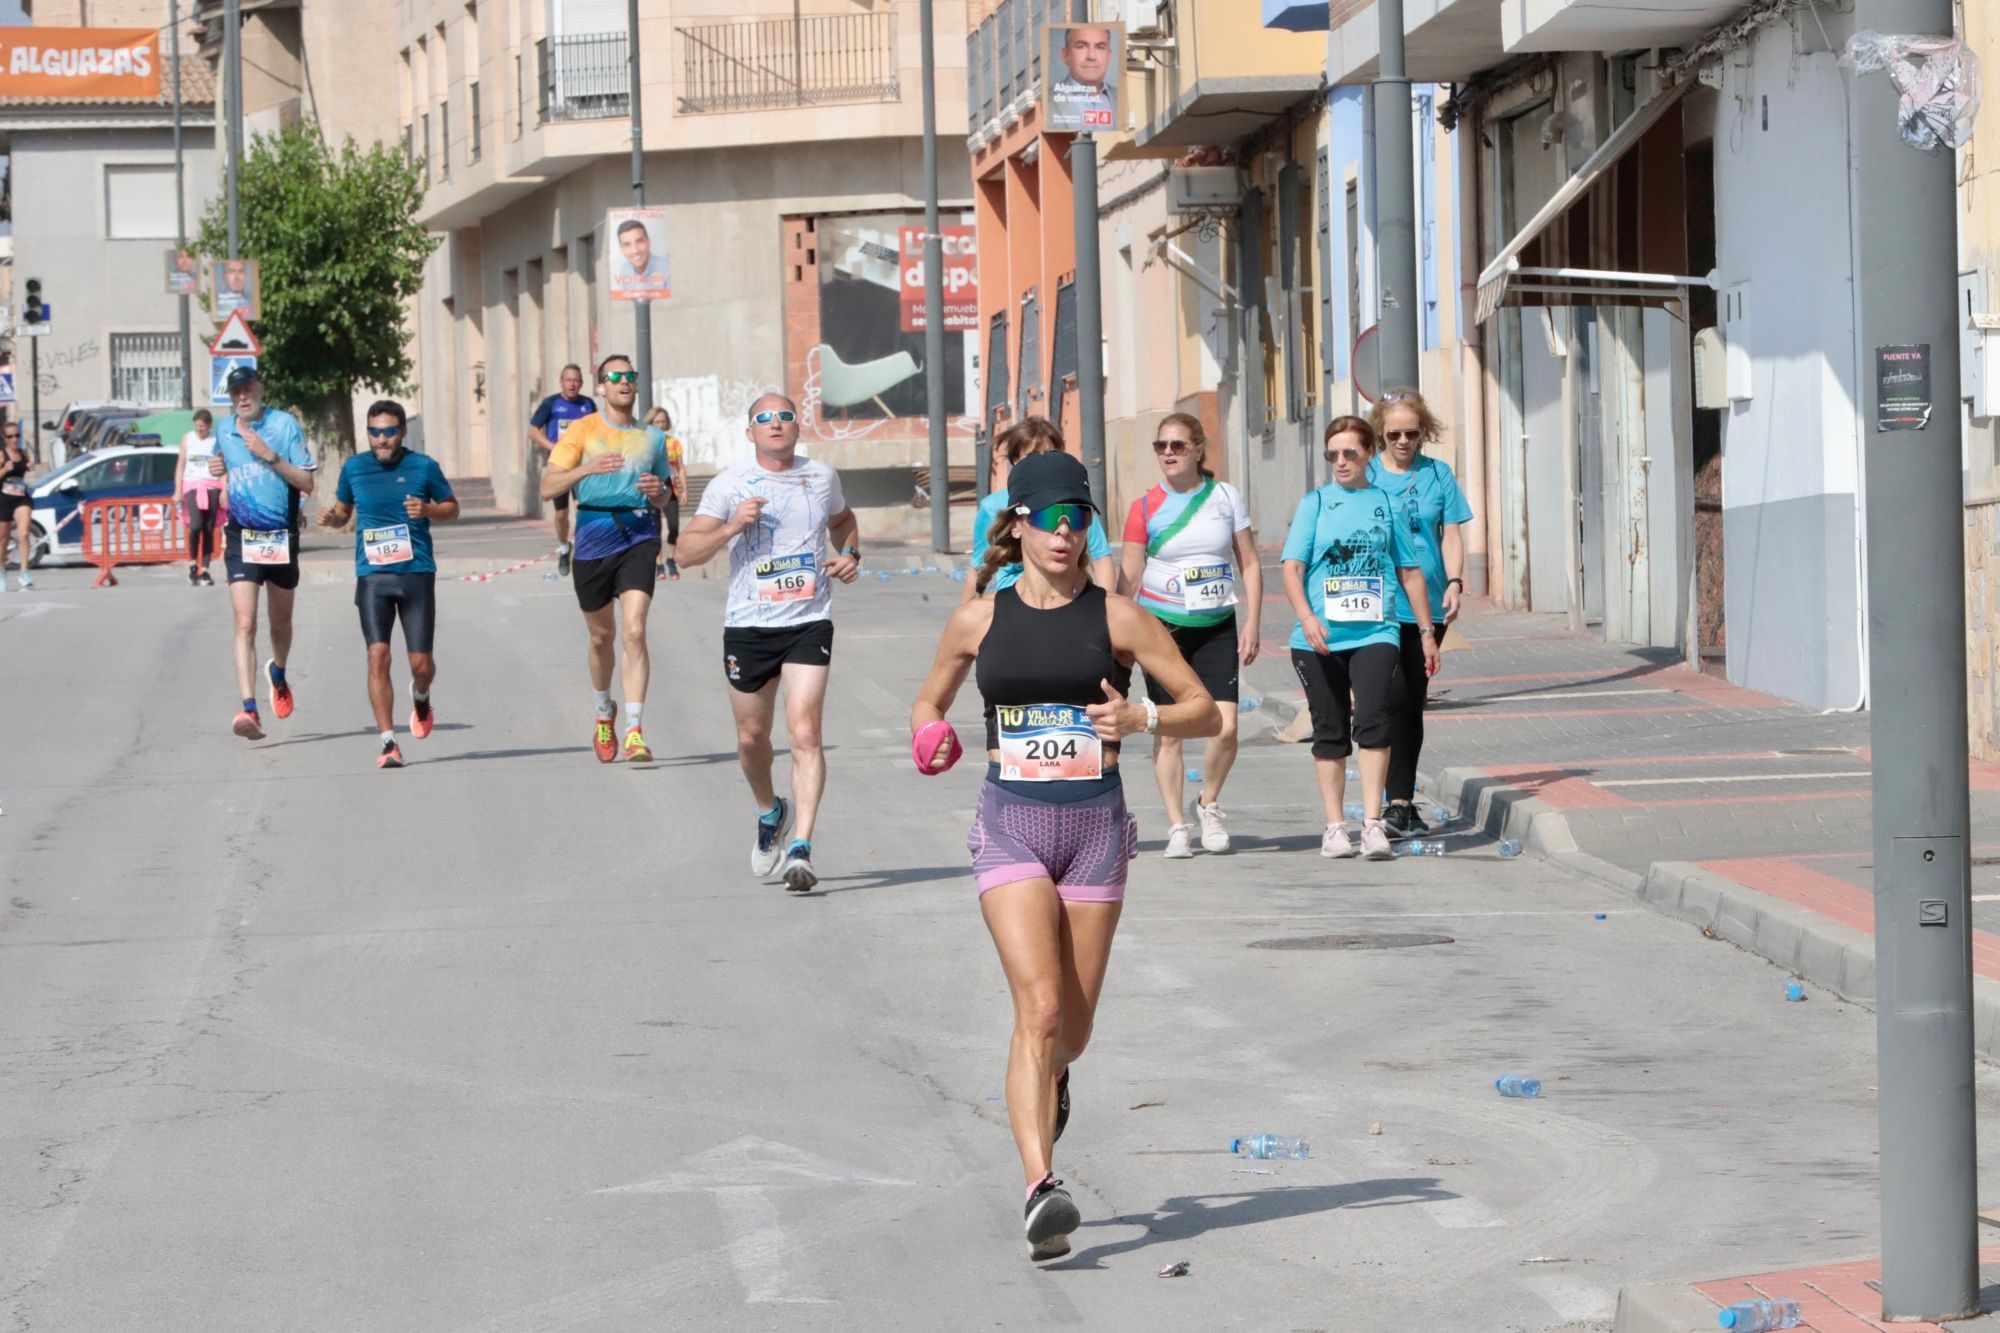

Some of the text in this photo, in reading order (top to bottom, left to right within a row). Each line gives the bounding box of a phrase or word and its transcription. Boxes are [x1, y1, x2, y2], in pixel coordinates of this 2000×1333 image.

[9, 46, 152, 77] ALGUAZAS
[1054, 83, 1097, 93] Alguazas
[1053, 94, 1066, 102] de
[1883, 352, 1921, 361] PUENTE YA
[260, 546, 274, 555] 75
[377, 543, 400, 556] 182
[774, 575, 805, 590] 166
[1200, 583, 1225, 597] 441
[1341, 598, 1370, 609] 416
[1027, 710, 1057, 719] VILLA
[1060, 710, 1074, 719] DE
[1025, 739, 1077, 760] 204
